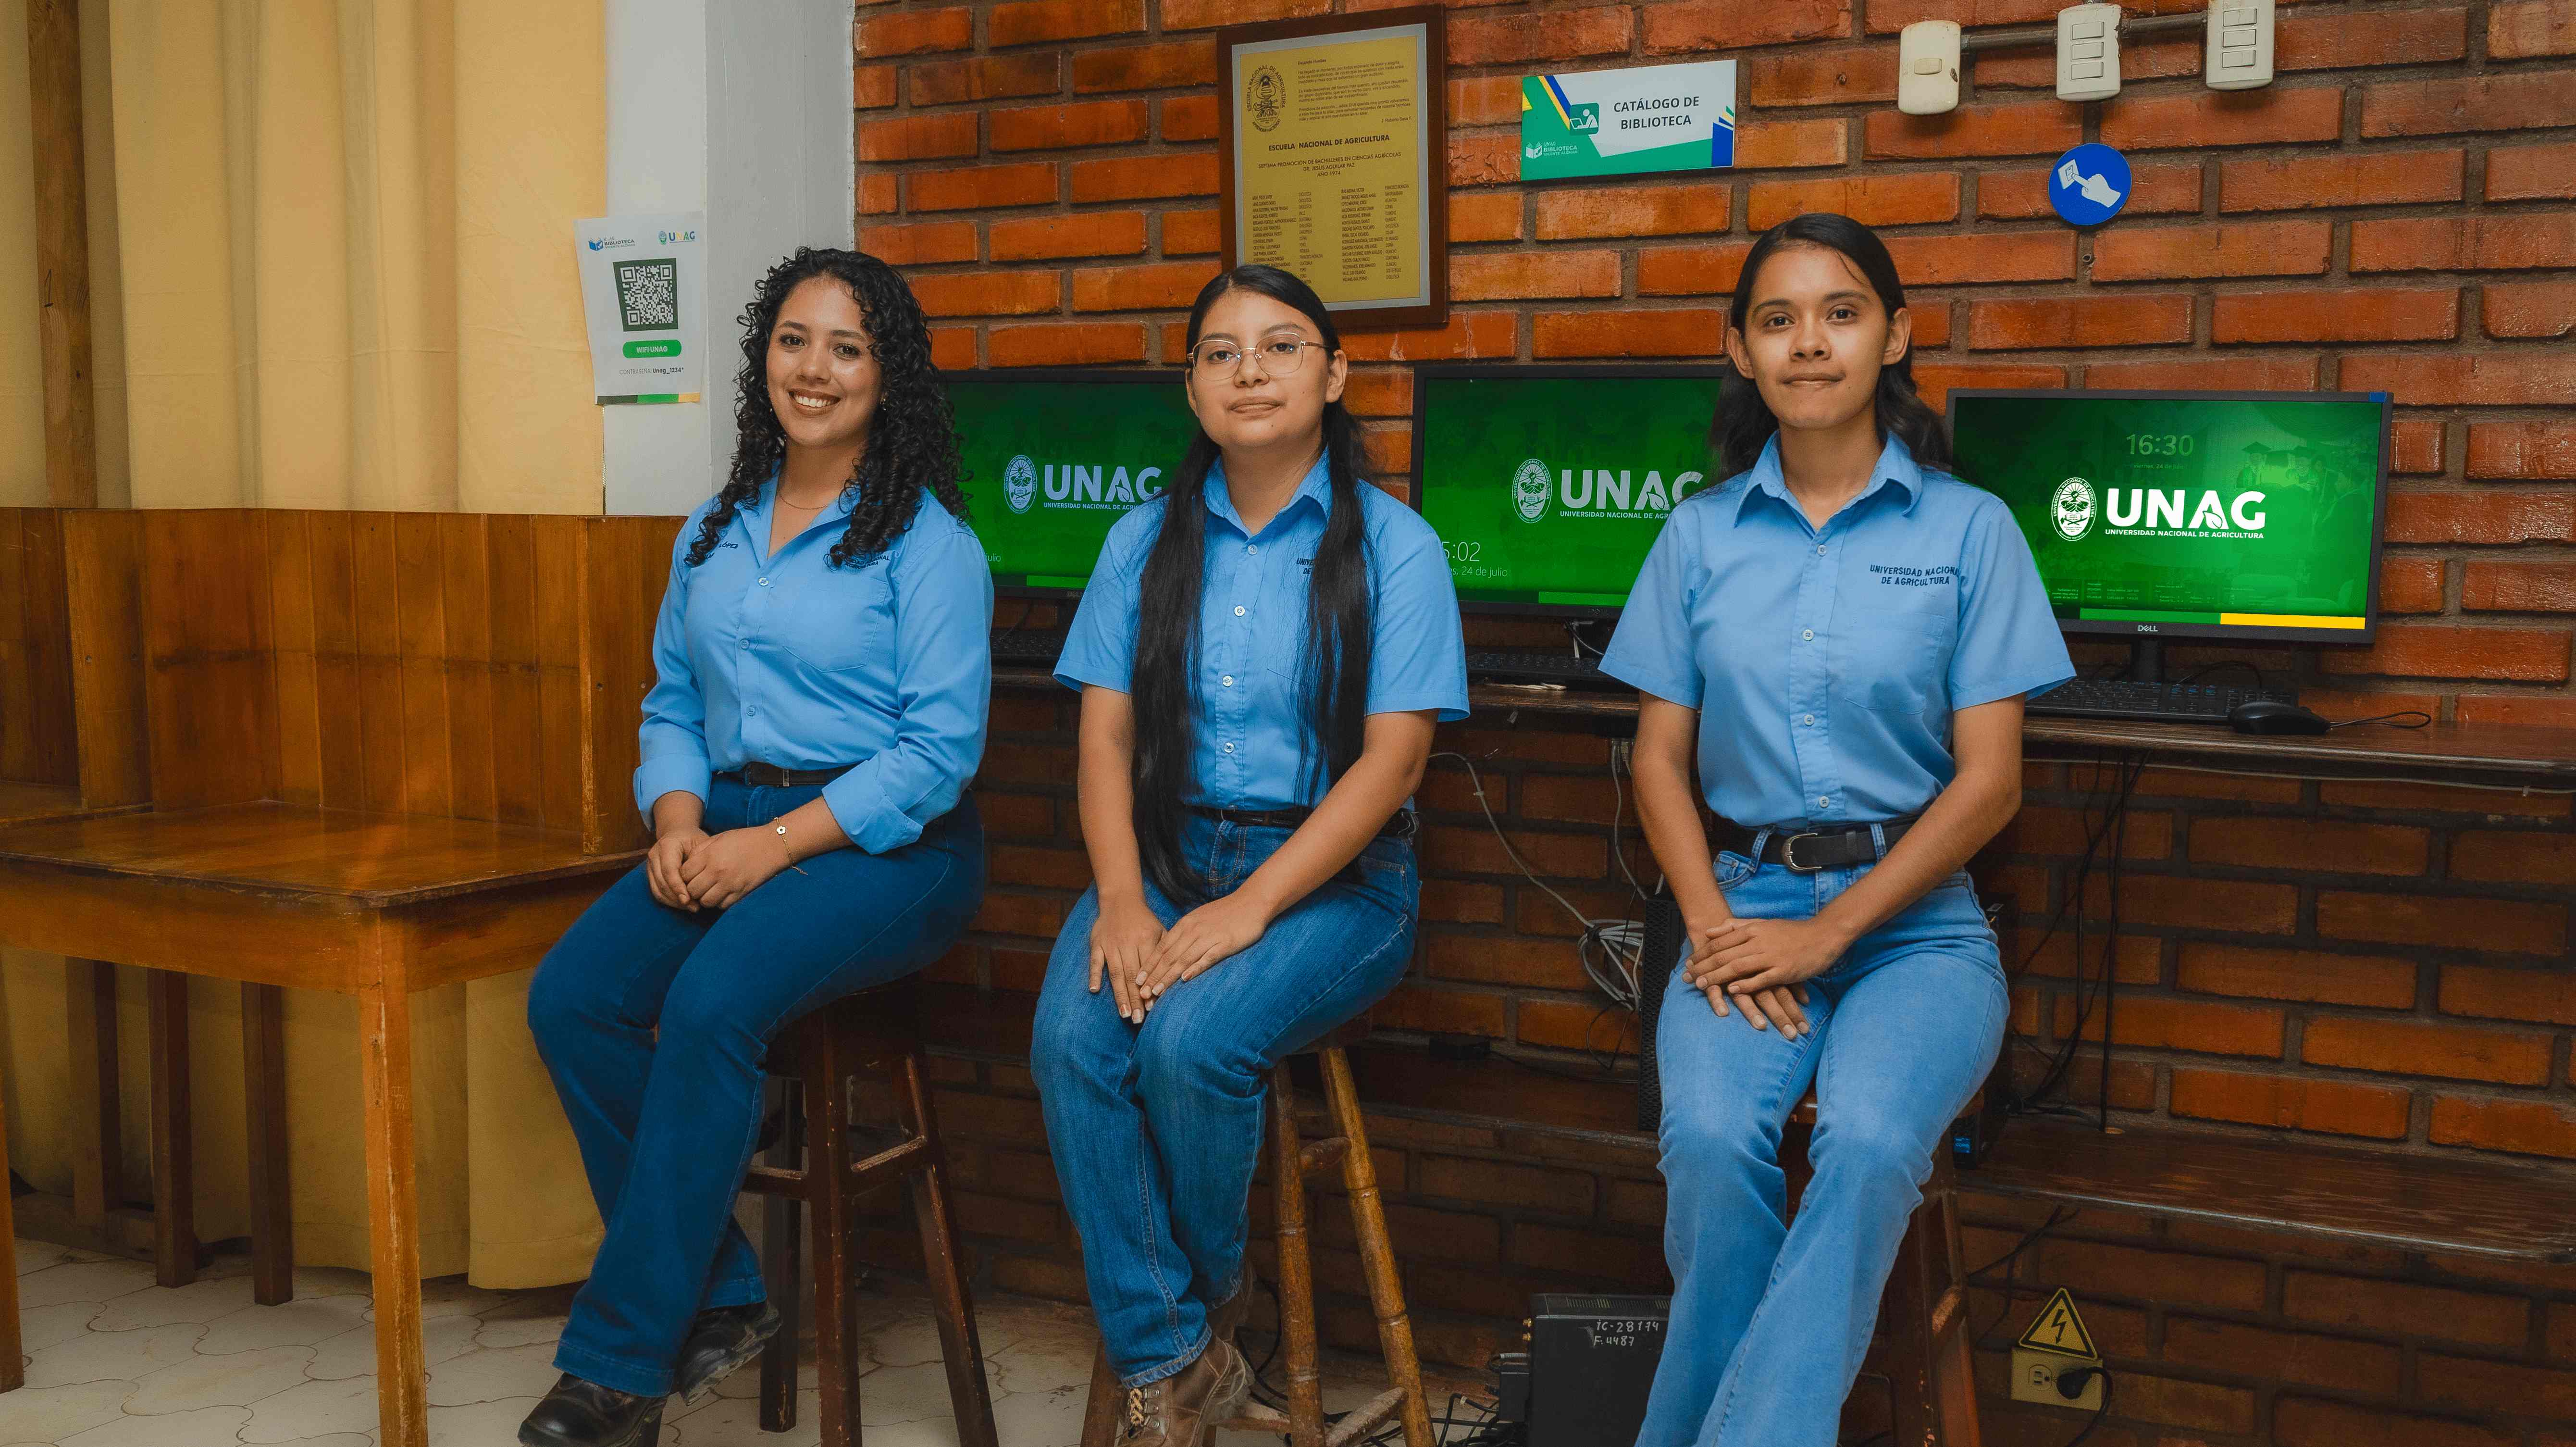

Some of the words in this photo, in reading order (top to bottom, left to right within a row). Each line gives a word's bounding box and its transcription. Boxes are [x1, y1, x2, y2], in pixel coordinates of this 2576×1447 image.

[1614, 98, 1680, 112] CATÁLOGO
[1684, 96, 1699, 107] DE
[1621, 115, 1692, 130] BIBLIOTECA
[1299, 140, 1333, 150] NACIONAL
[1344, 134, 1390, 145] AGRICULTURA
[669, 231, 695, 241] UNAG
[2126, 434, 2194, 456] 16:30
[1044, 464, 1162, 502] UNAG
[2061, 479, 2083, 489] NACIONAL
[2106, 488, 2266, 530] UNAG
[1442, 541, 1480, 561] 5:02
[1461, 566, 1473, 575] 24
[1475, 566, 1487, 576] de
[1487, 567, 1508, 579] julio
[1870, 564, 1922, 577] UNIVERSIDAD
[1895, 576, 1950, 586] AGRICULTURA
